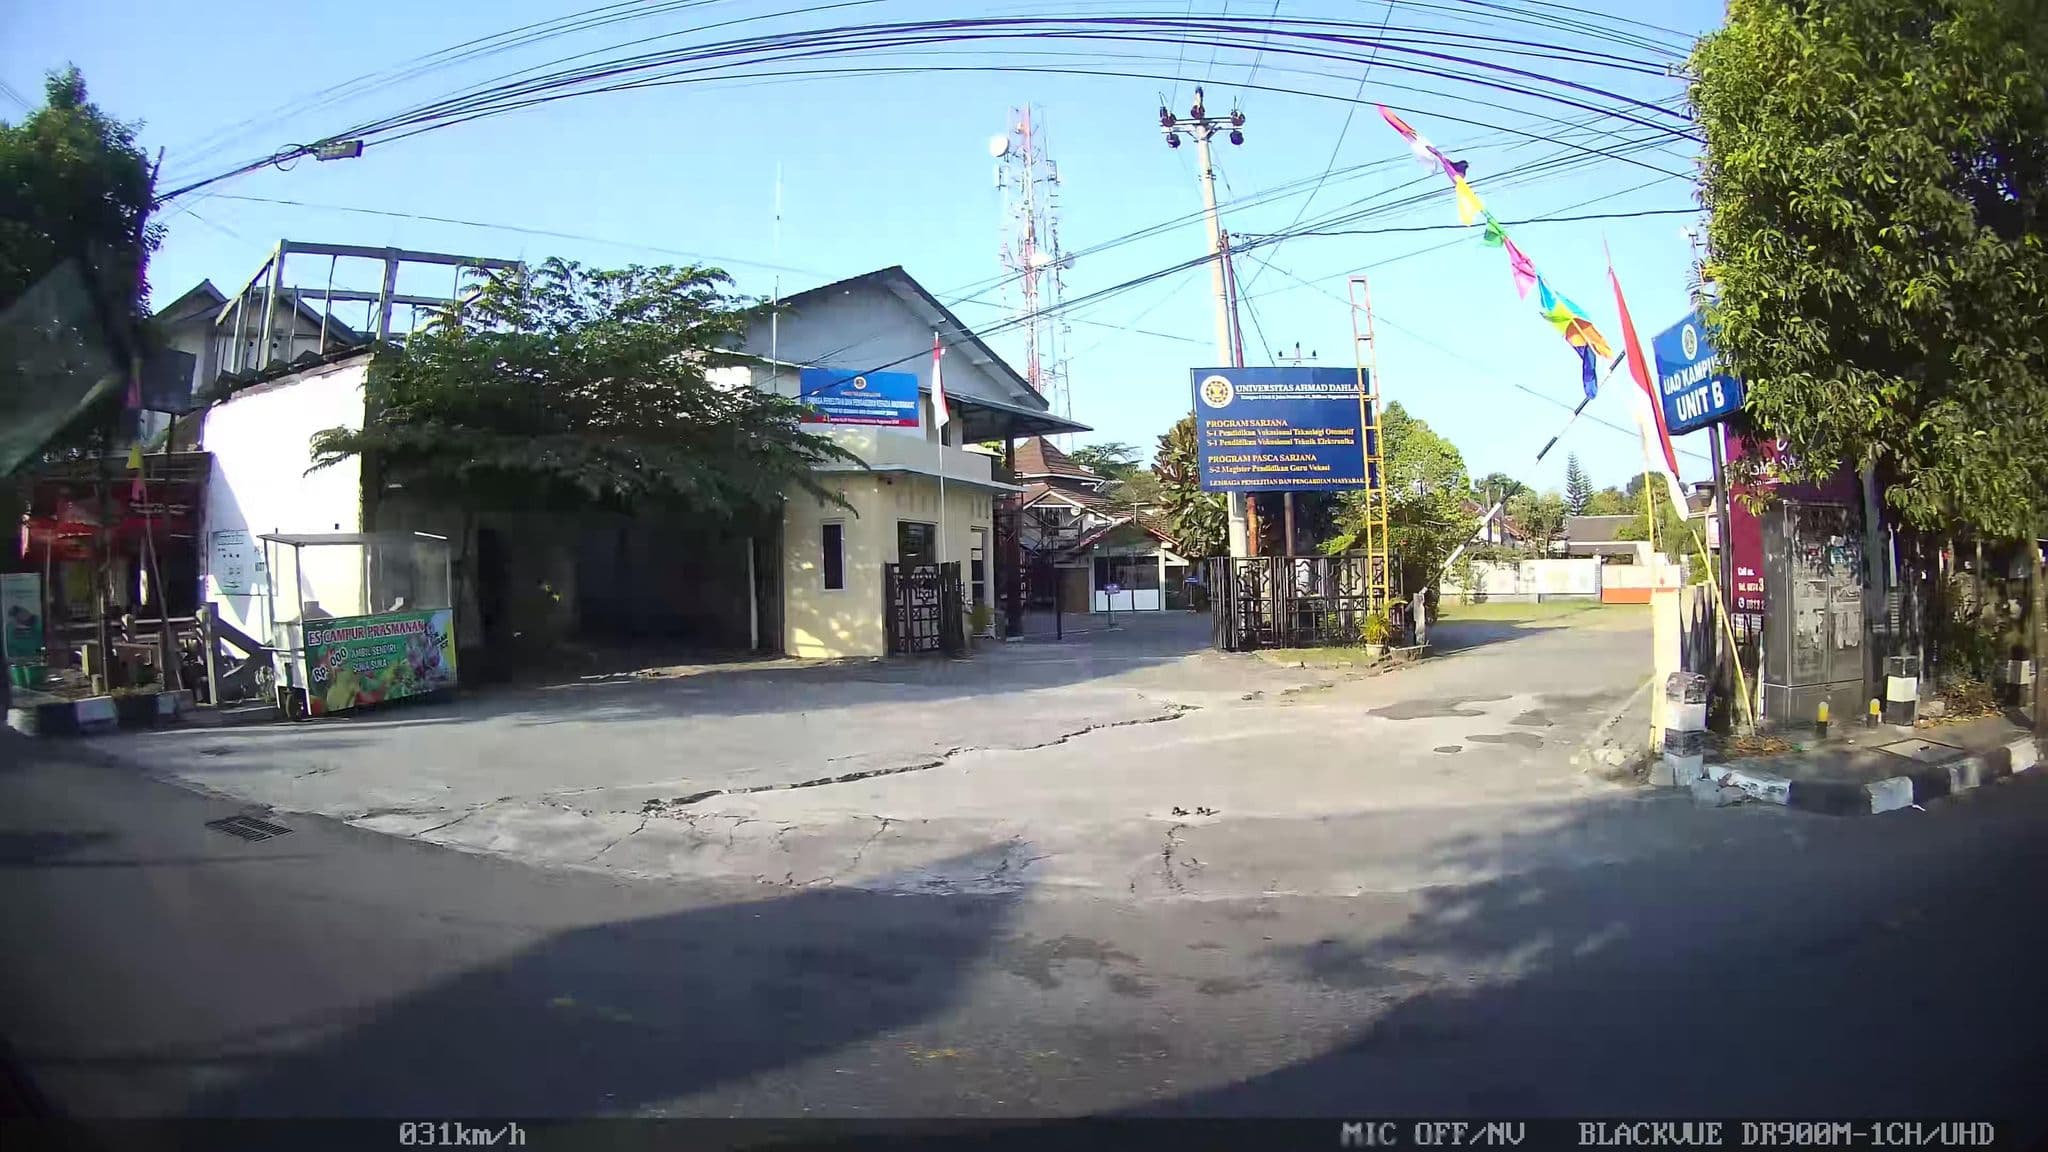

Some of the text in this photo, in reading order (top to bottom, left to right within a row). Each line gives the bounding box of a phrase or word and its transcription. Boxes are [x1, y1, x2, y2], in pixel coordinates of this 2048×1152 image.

[1235, 384, 1294, 392] UNIVERSITAS
[1295, 384, 1328, 392] AHMAD
[1664, 373, 1682, 395] UAD
[1676, 381, 1725, 422] UNIT B
[1207, 419, 1288, 428] PROGRAM SARJANA
[1219, 429, 1256, 437] Pendidikan
[1208, 453, 1318, 463] PROGRAM PASCA SARJANA
[1221, 465, 1250, 474] Magister
[1252, 464, 1289, 472] Pendidikan
[1290, 464, 1308, 472] Guru
[1308, 463, 1331, 471] Vokasi
[308, 619, 425, 646] ES CAMPUR PRASMANAN
